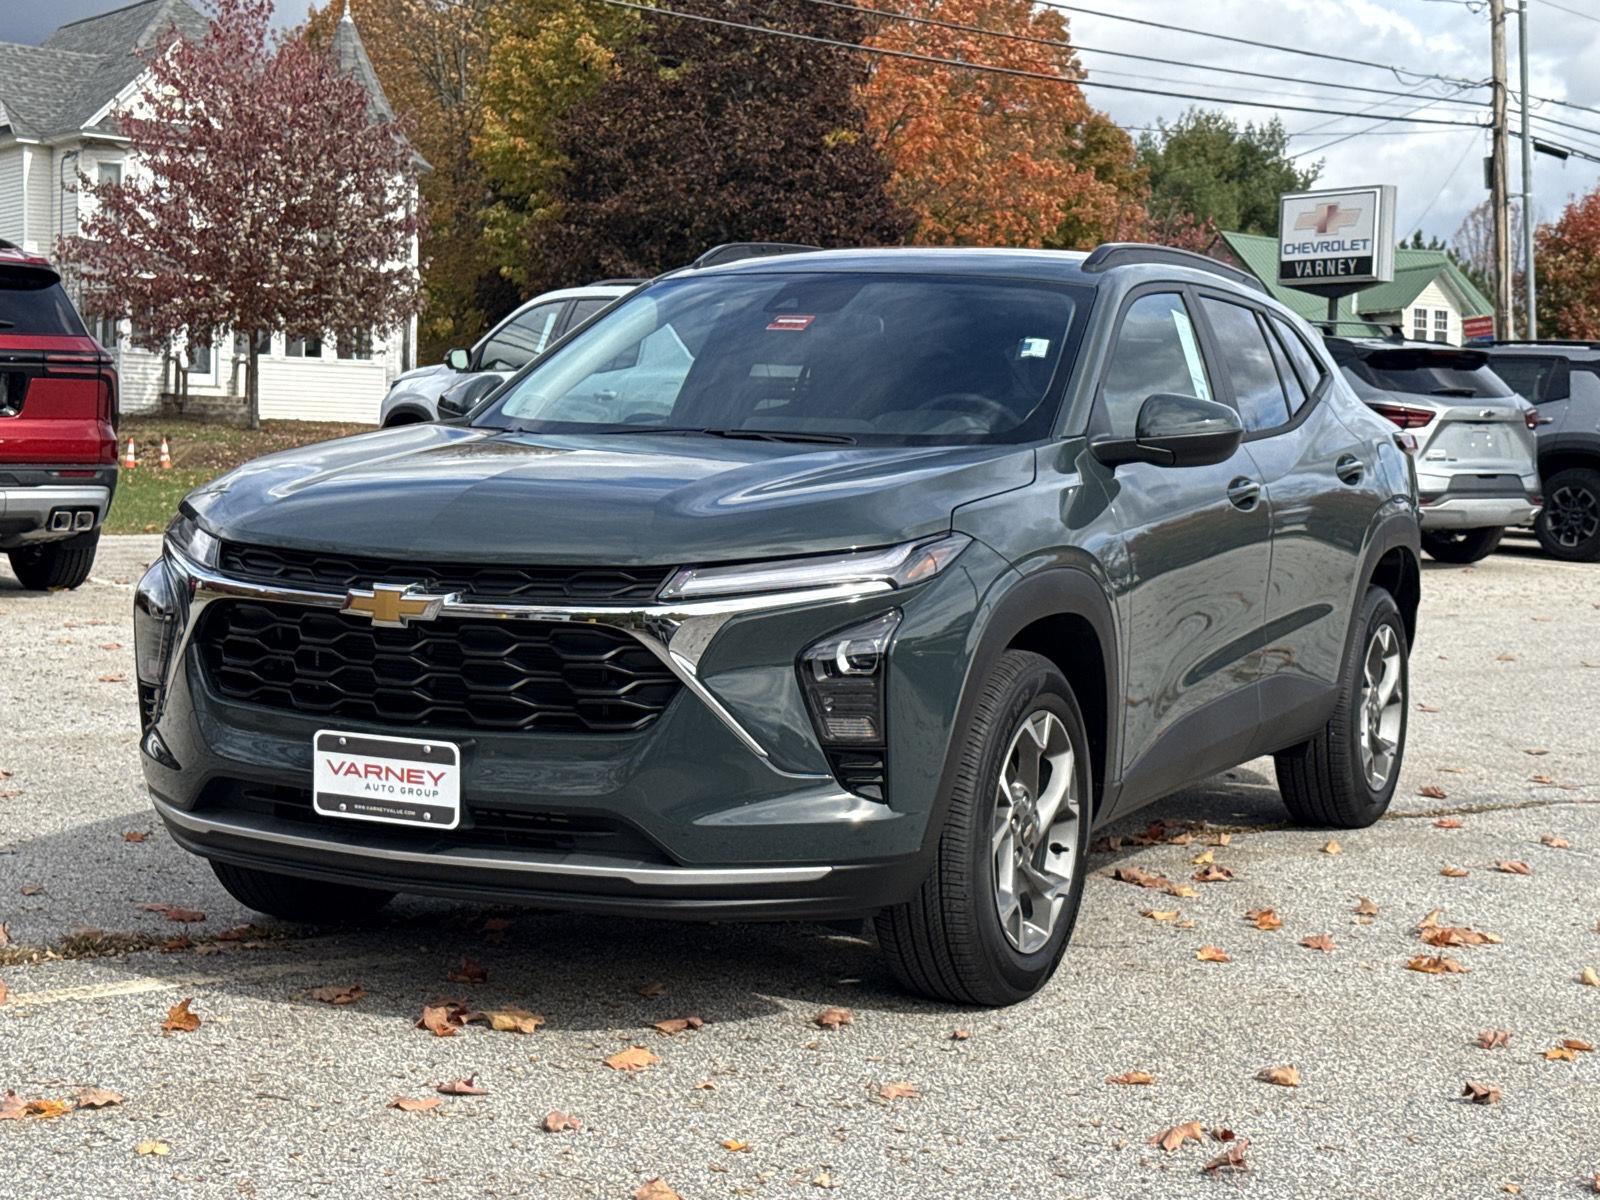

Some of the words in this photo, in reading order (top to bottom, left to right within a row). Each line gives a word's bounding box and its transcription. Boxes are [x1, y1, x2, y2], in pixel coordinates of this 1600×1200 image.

[1284, 239, 1370, 255] CHEVROLET
[1295, 258, 1357, 277] VARNEY
[326, 759, 446, 786] VARNEY
[365, 783, 395, 793] AUTO
[400, 787, 439, 797] GROUP
